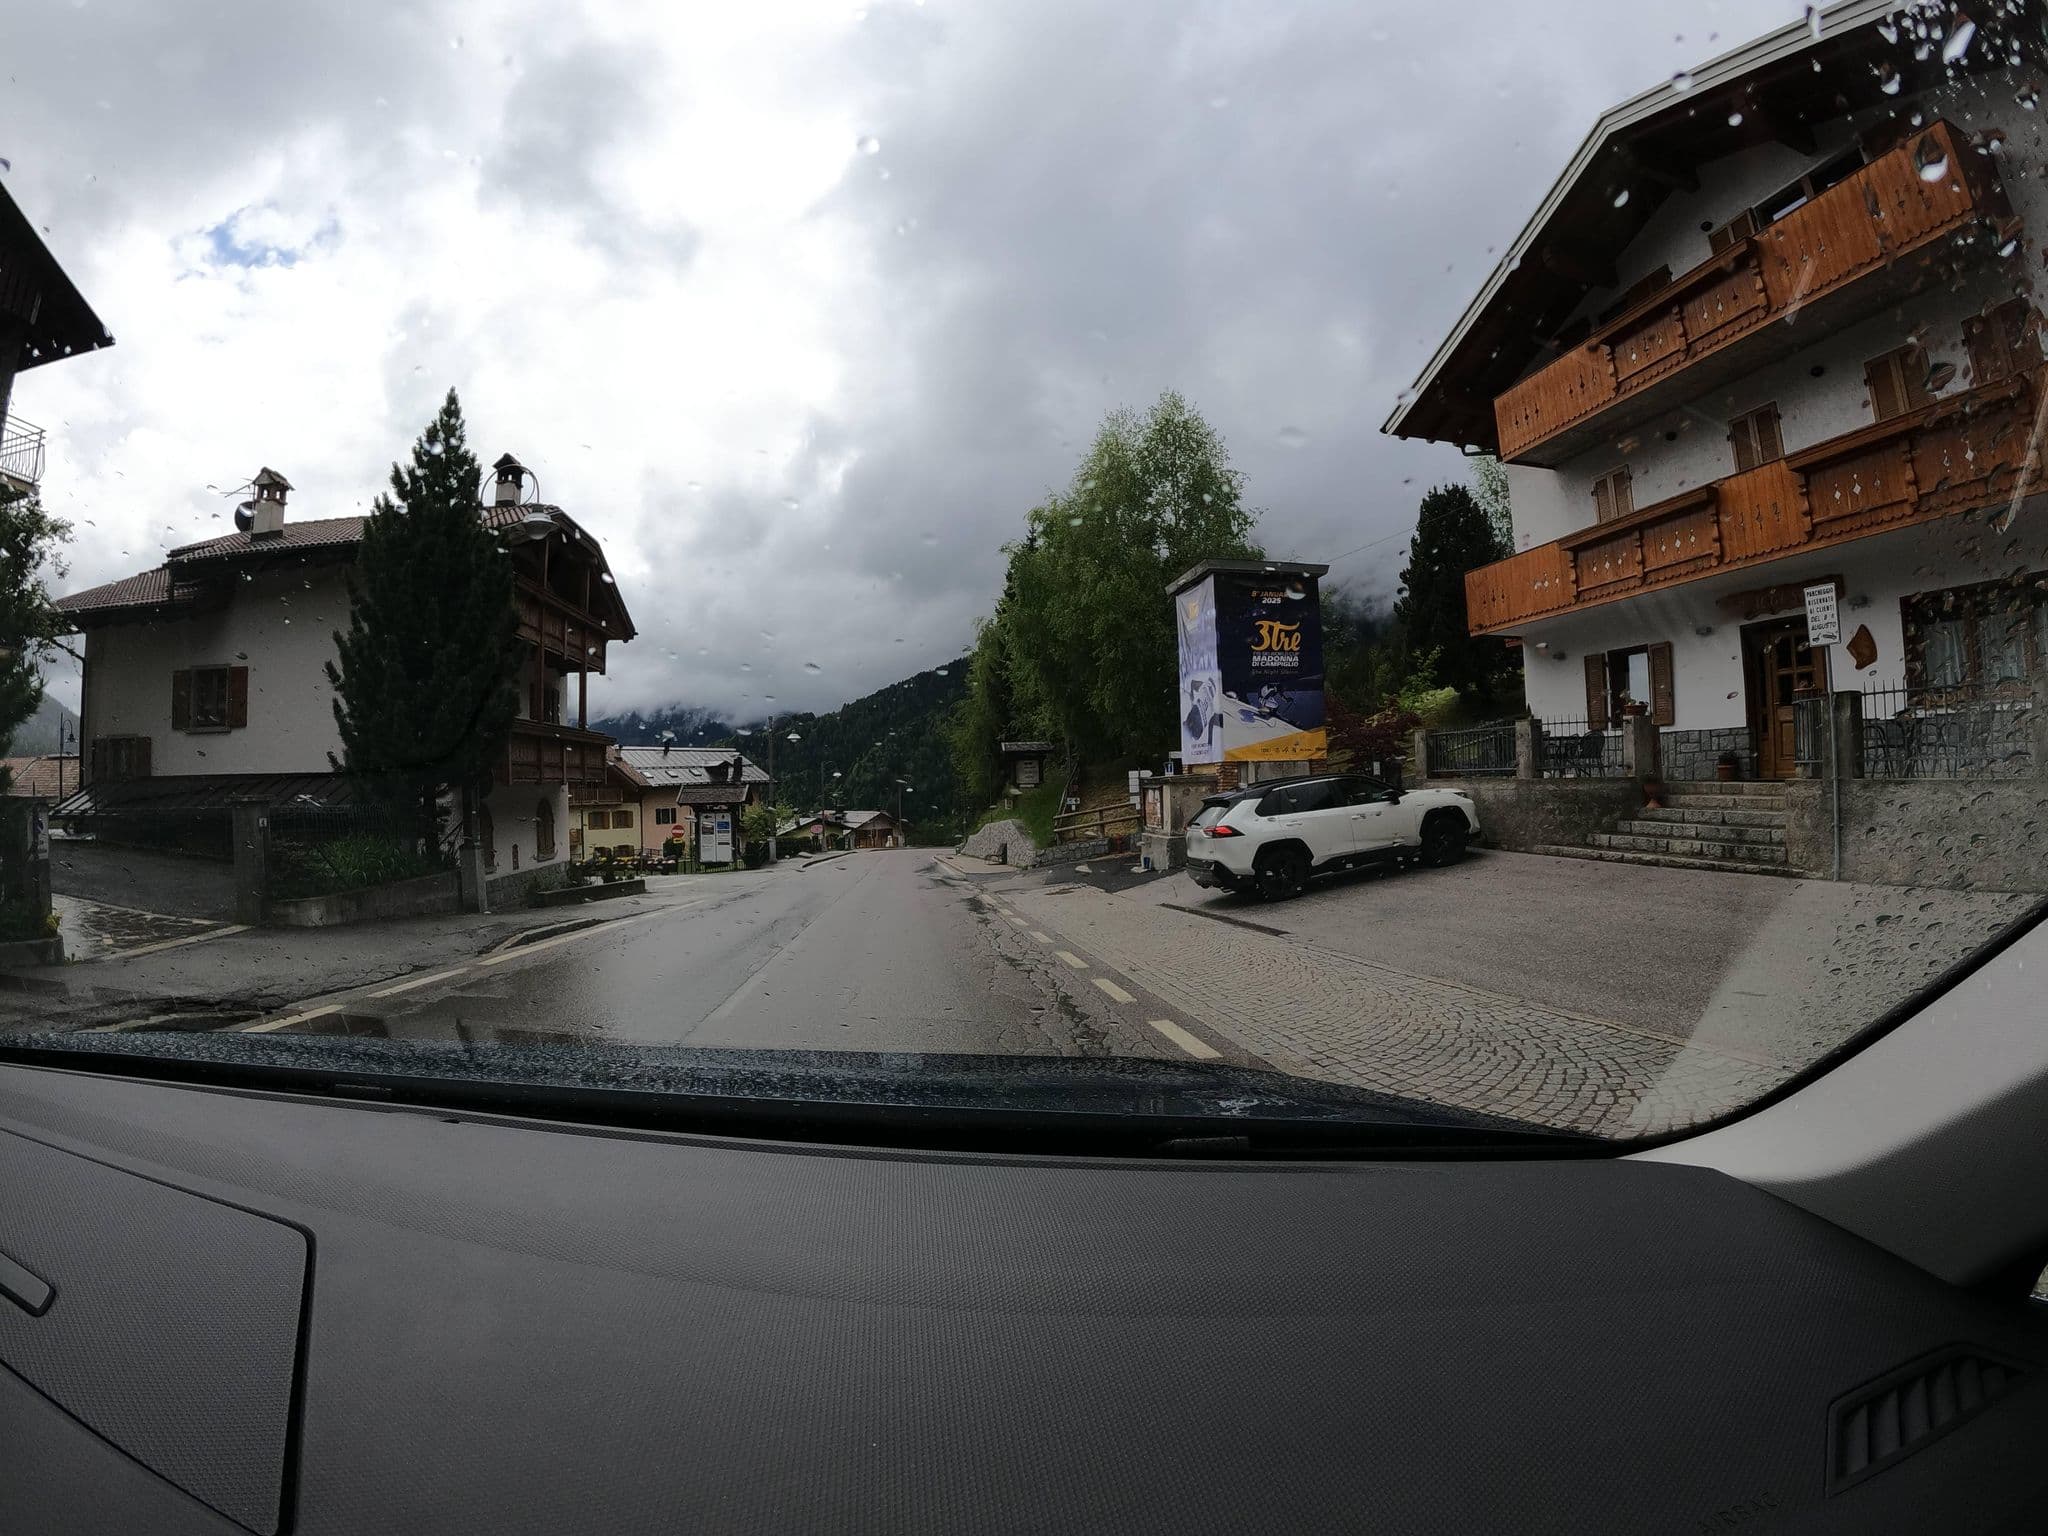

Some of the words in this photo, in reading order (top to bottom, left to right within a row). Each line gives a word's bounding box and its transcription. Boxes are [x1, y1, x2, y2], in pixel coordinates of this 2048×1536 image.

[1807, 587, 1833, 597] PARCHEGGIO
[1808, 596, 1833, 606] RISERVATO
[1816, 604, 1834, 613] CLIENTI
